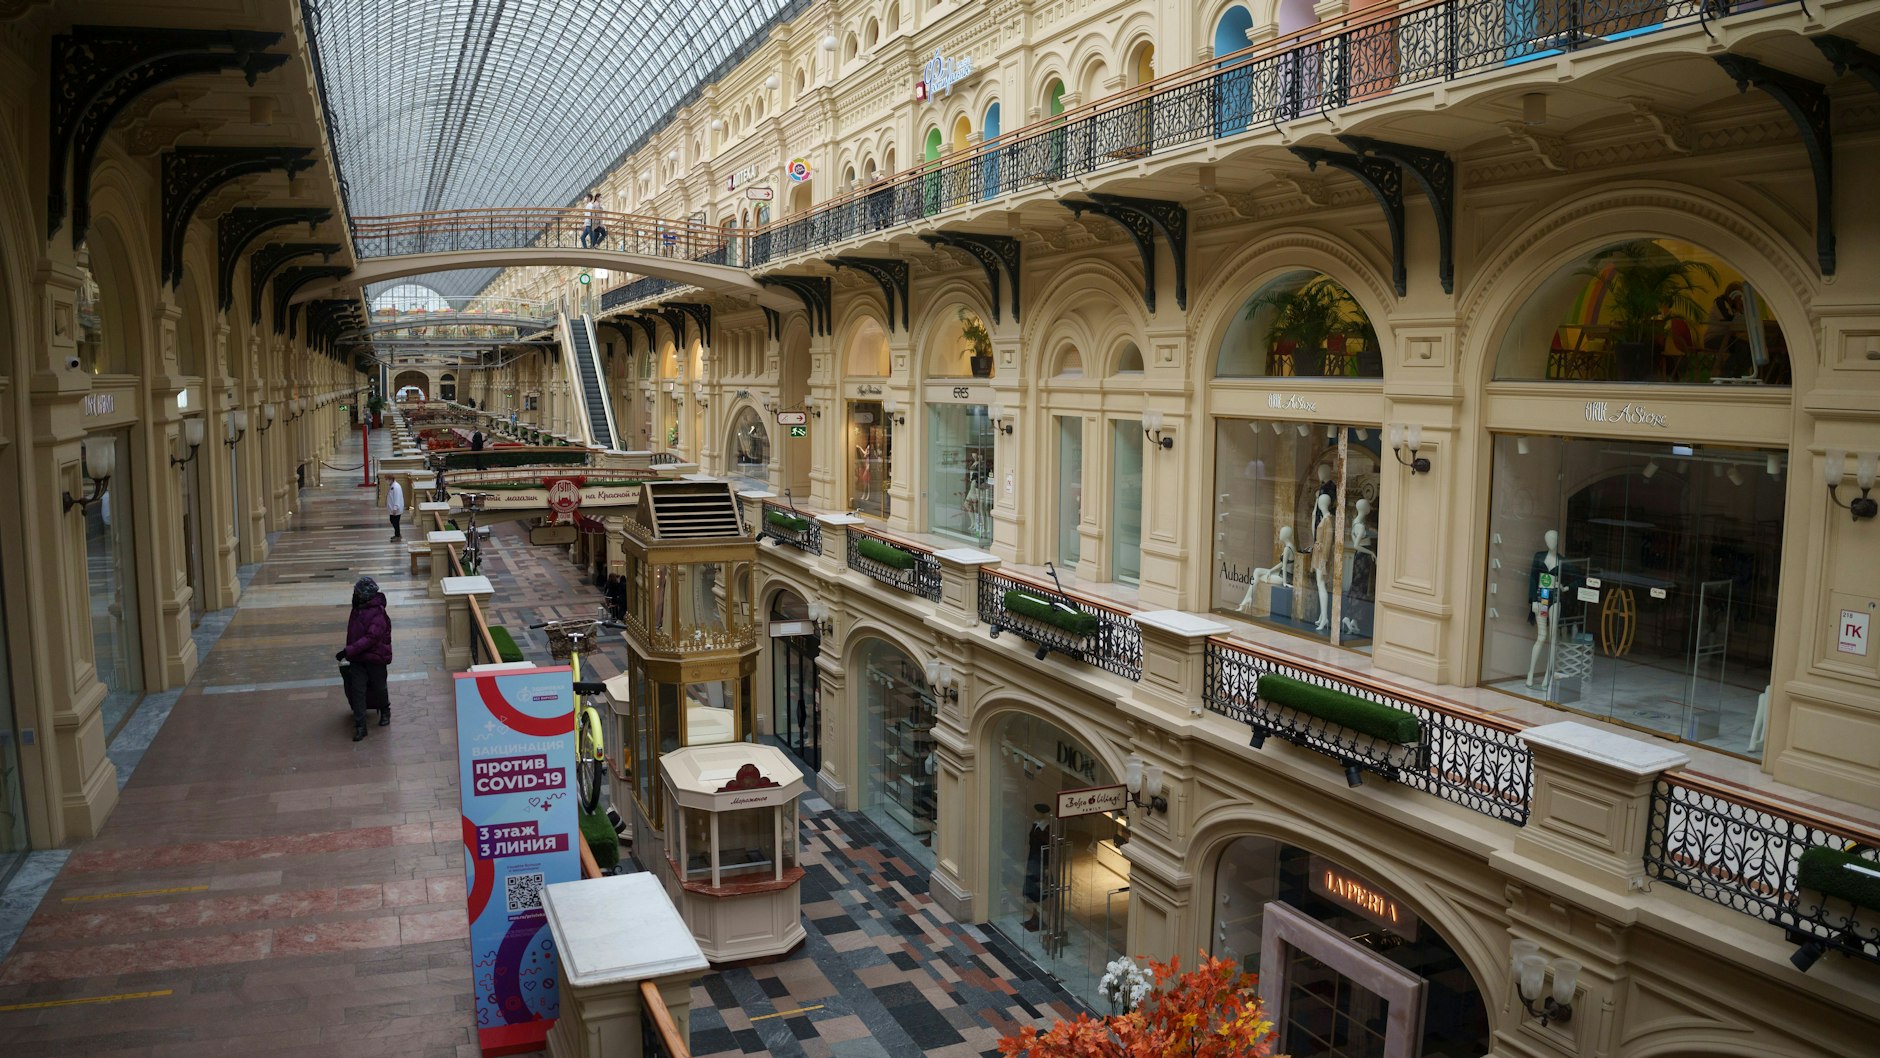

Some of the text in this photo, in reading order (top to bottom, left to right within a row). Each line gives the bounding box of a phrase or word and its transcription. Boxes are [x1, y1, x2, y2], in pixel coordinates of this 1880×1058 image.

[953, 387, 969, 399] ERES
[557, 481, 572, 493] ГУМ
[598, 489, 630, 501] Красной
[1219, 561, 1255, 586] Aubade
[1845, 623, 1862, 639] ПК
[472, 740, 565, 757] ВАКЦИНАЦИЯ
[475, 758, 546, 776] против
[1056, 741, 1095, 782] DIOR
[476, 771, 563, 792] COVID-19
[479, 825, 536, 841] 3 этаж
[480, 837, 557, 857] 3 ЛИНИЯ
[1325, 871, 1344, 896] LA
